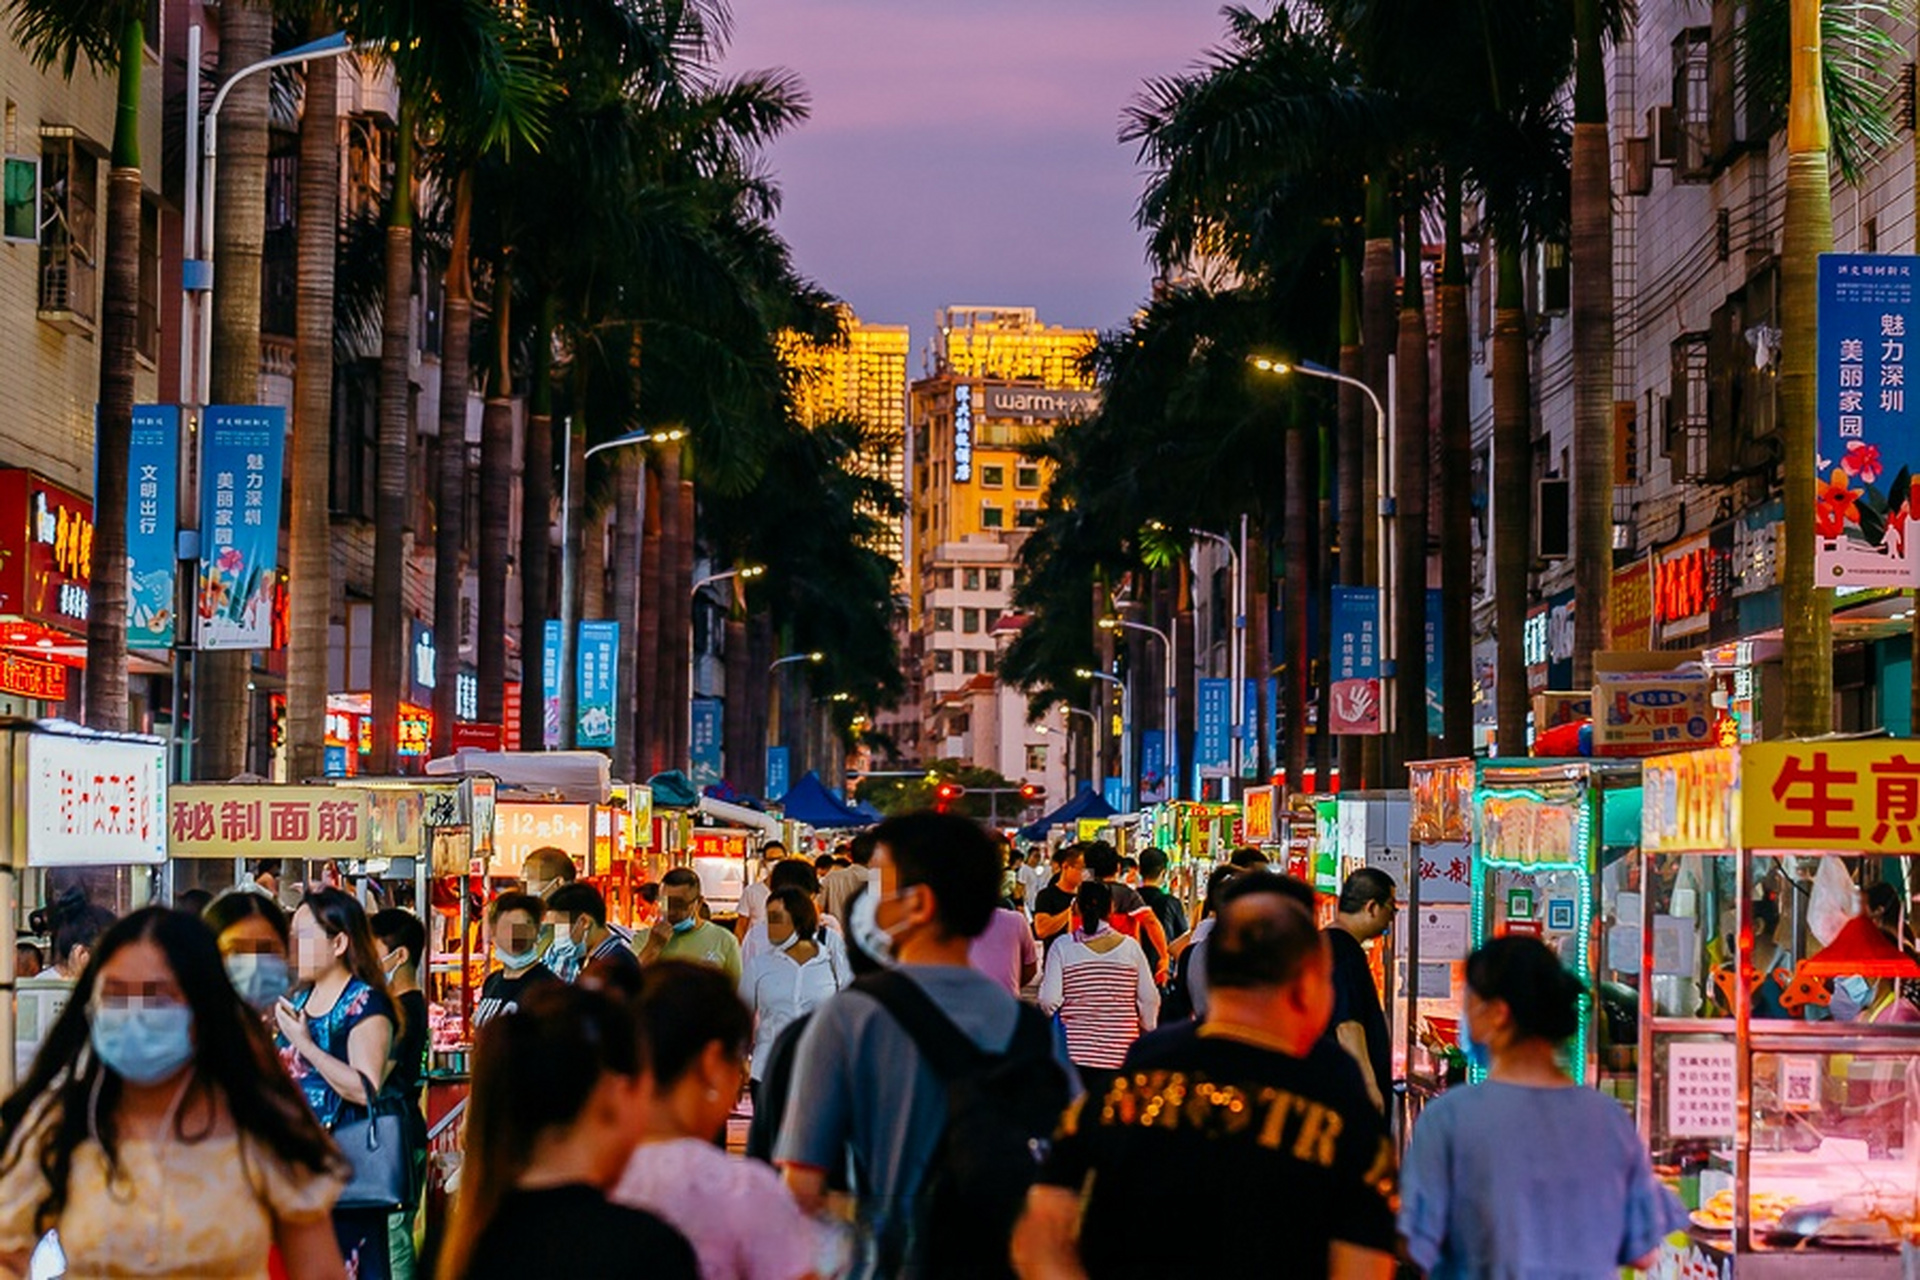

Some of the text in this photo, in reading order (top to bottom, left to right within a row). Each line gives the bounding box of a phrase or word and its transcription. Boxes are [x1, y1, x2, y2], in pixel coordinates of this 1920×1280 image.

[1839, 338, 1864, 438] 美丽家园
[1880, 313, 1905, 413] 魅力深圳
[139, 464, 159, 535] 文明出行
[214, 471, 235, 545] 美丽家园
[244, 453, 265, 526] 魅力深圳
[173, 800, 360, 843] 秘制面筋
[1771, 751, 1920, 845] 生煎
